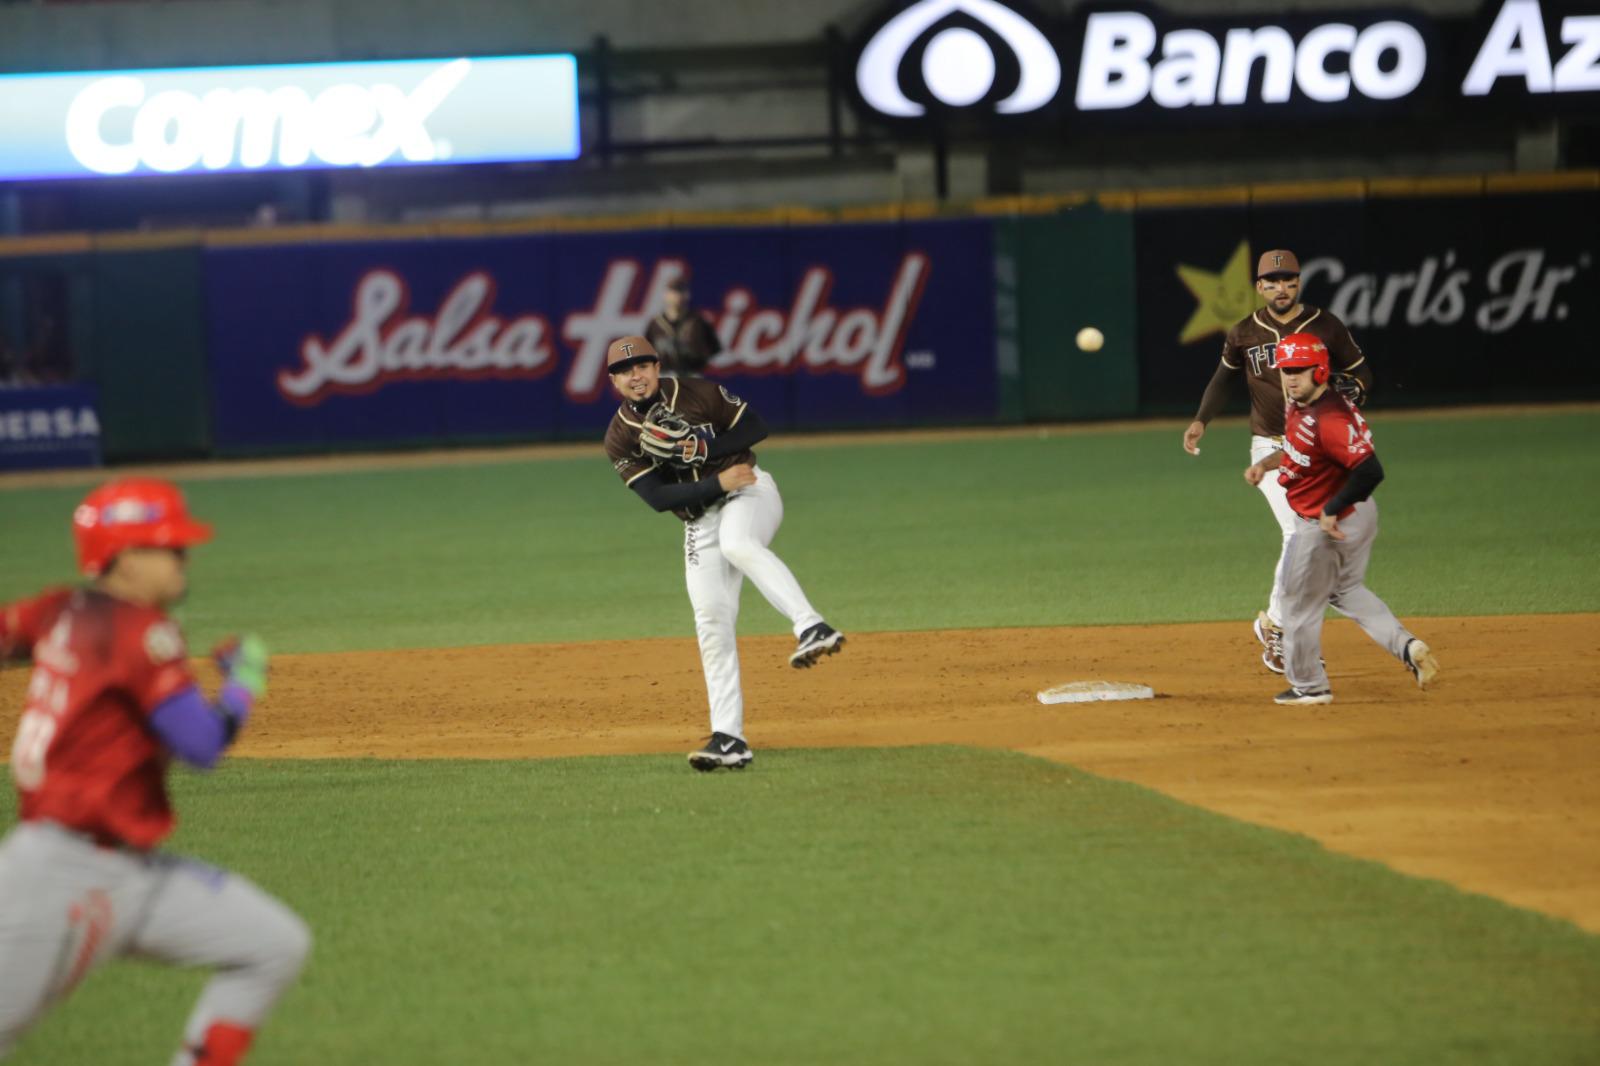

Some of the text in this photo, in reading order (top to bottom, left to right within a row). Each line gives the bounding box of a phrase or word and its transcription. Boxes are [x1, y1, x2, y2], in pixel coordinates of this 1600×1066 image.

[1076, 0, 1600, 111] Banco Az
[65, 58, 471, 174] Comex
[1272, 255, 1283, 268] T
[1475, 249, 1576, 333] Jr.
[280, 270, 554, 402] Salsa
[561, 251, 930, 398] Hichol
[619, 343, 635, 359] T
[0, 406, 101, 440] ERSA
